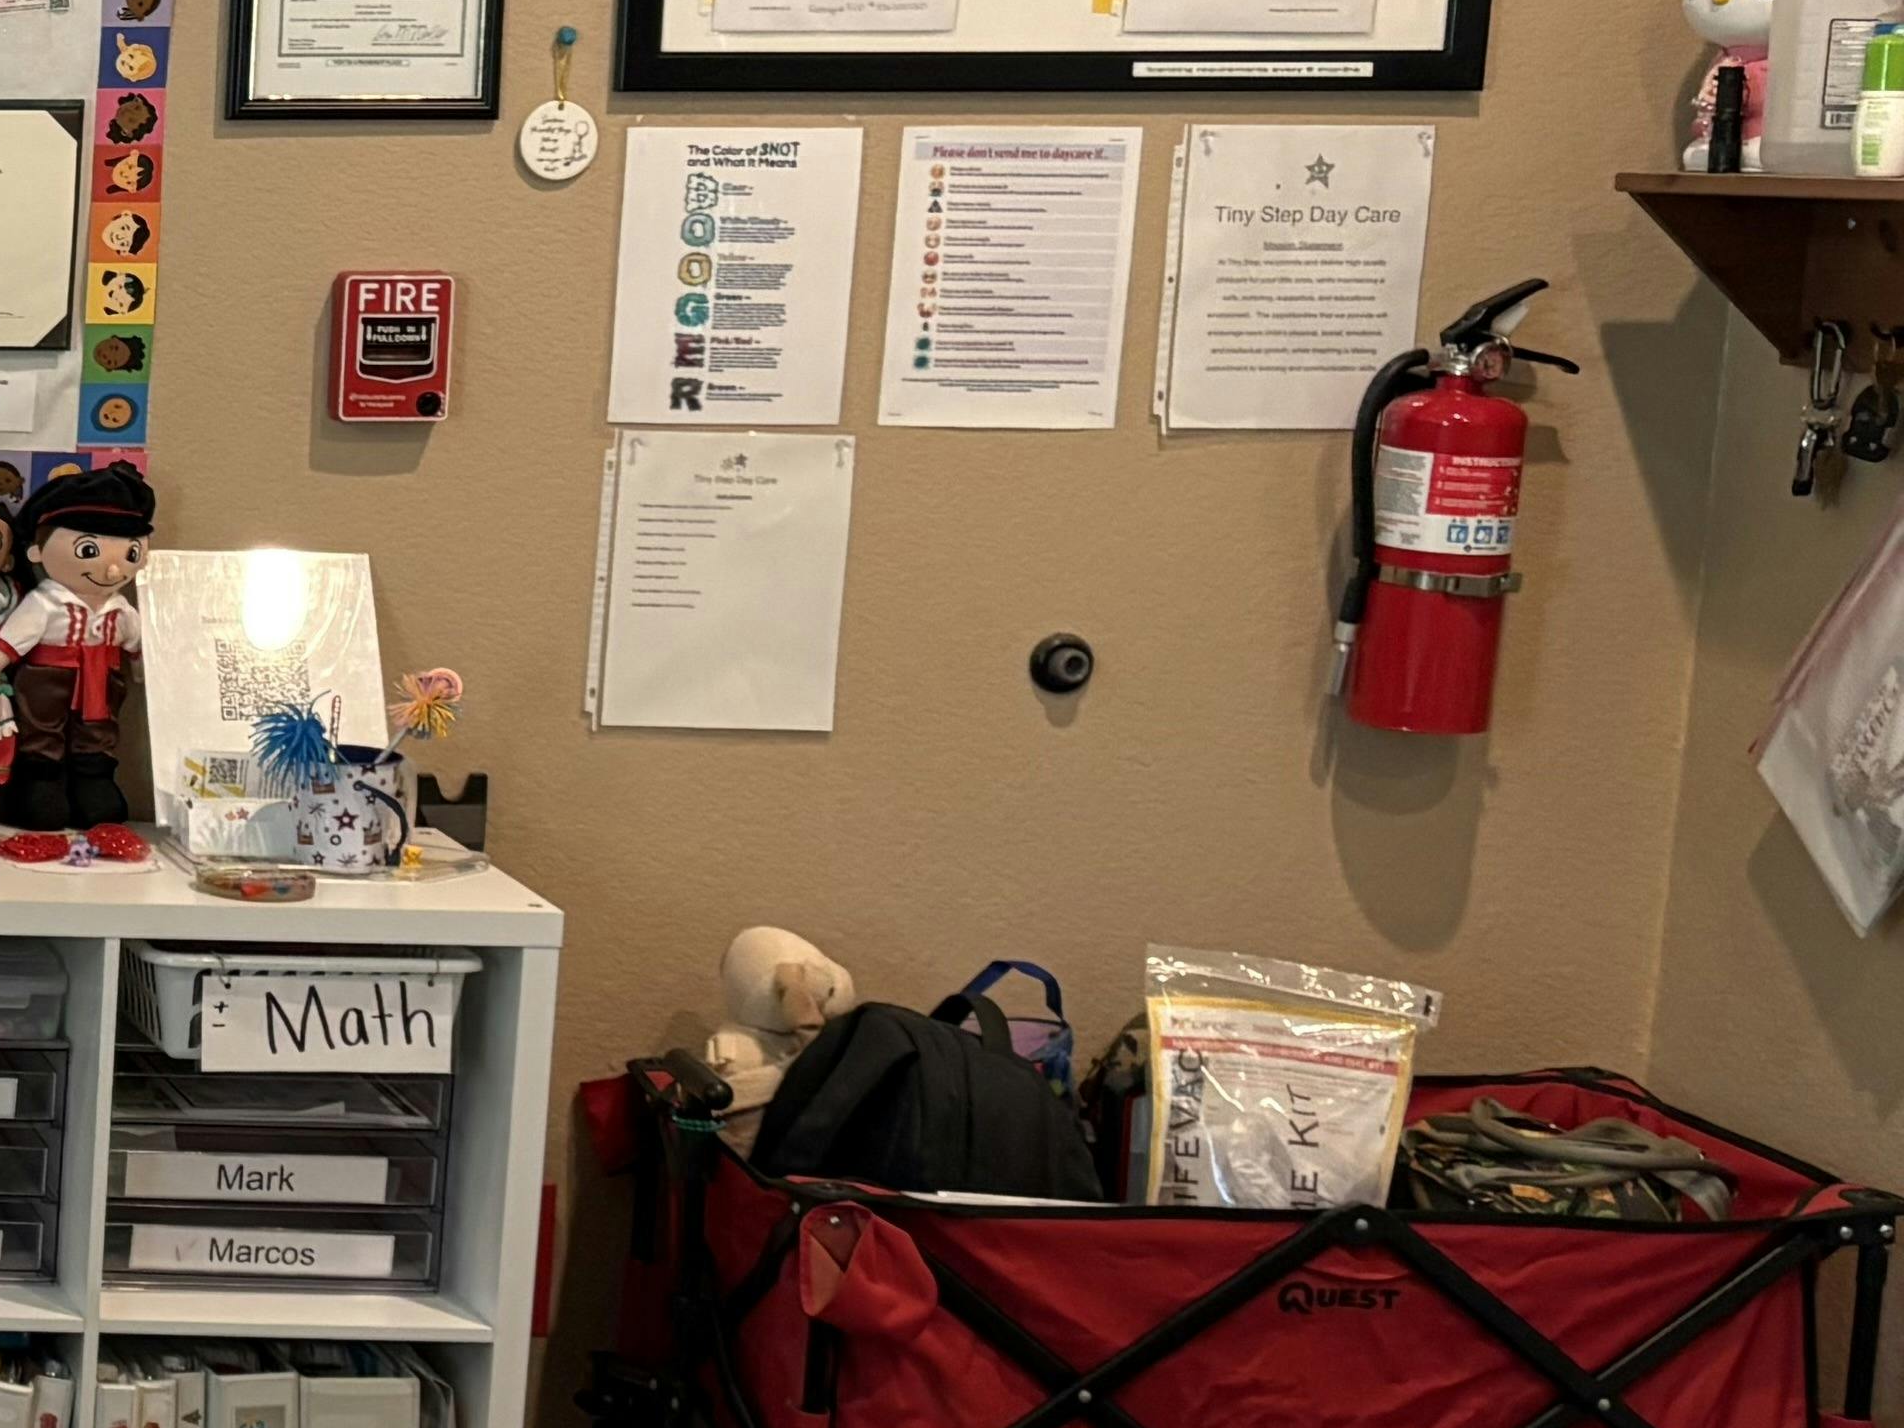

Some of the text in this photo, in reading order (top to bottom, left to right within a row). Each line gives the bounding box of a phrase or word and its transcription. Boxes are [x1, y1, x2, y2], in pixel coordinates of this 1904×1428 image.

[687, 157, 710, 168] and
[713, 158, 745, 168] What
[758, 158, 797, 168] Means
[688, 141, 800, 157] The Color of SNOT
[1215, 205, 1401, 226] Tiny Step Day Care
[358, 282, 441, 312] FIRE
[266, 983, 436, 1055] Math
[1286, 1084, 1319, 1148] KIT
[217, 1164, 294, 1192] Mark
[208, 1239, 316, 1267] Marcos
[1278, 1281, 1401, 1314] QUEST
